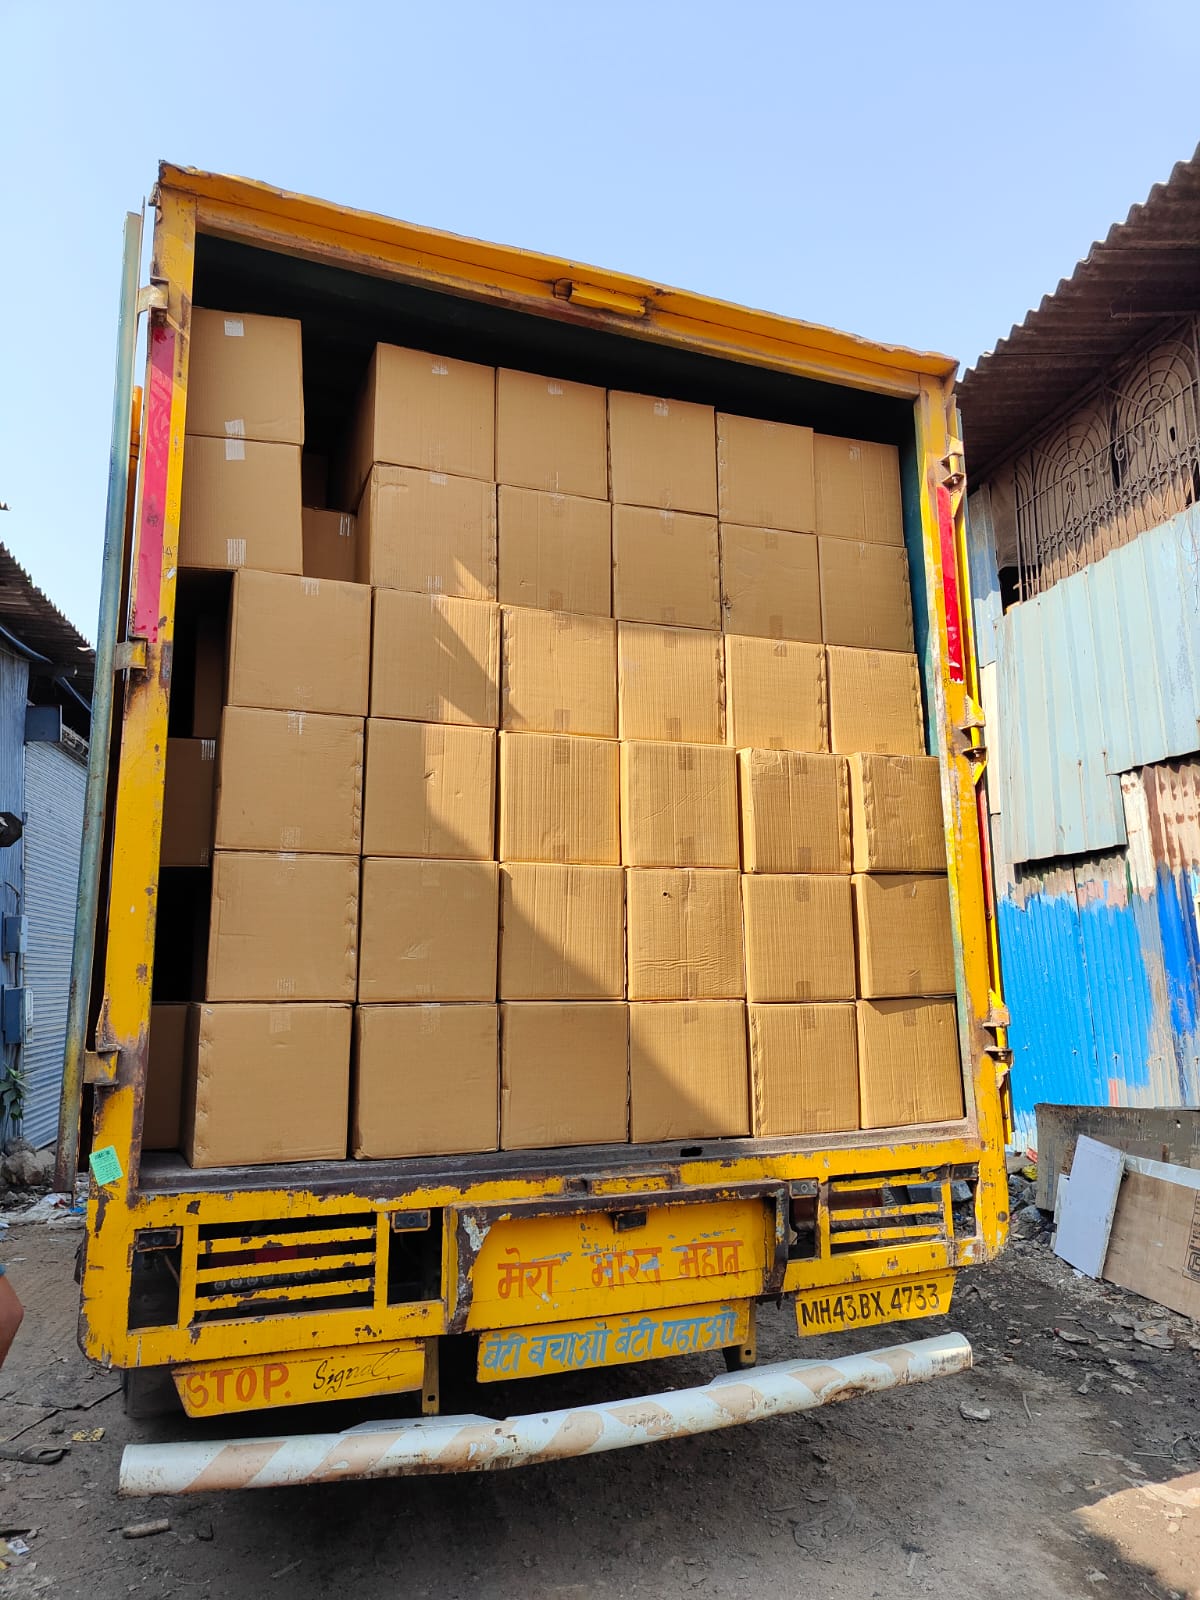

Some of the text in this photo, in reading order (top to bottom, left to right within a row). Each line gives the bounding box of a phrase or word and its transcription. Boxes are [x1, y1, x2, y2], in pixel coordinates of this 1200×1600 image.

[497, 1239, 744, 1300] मेरा भारत महान
